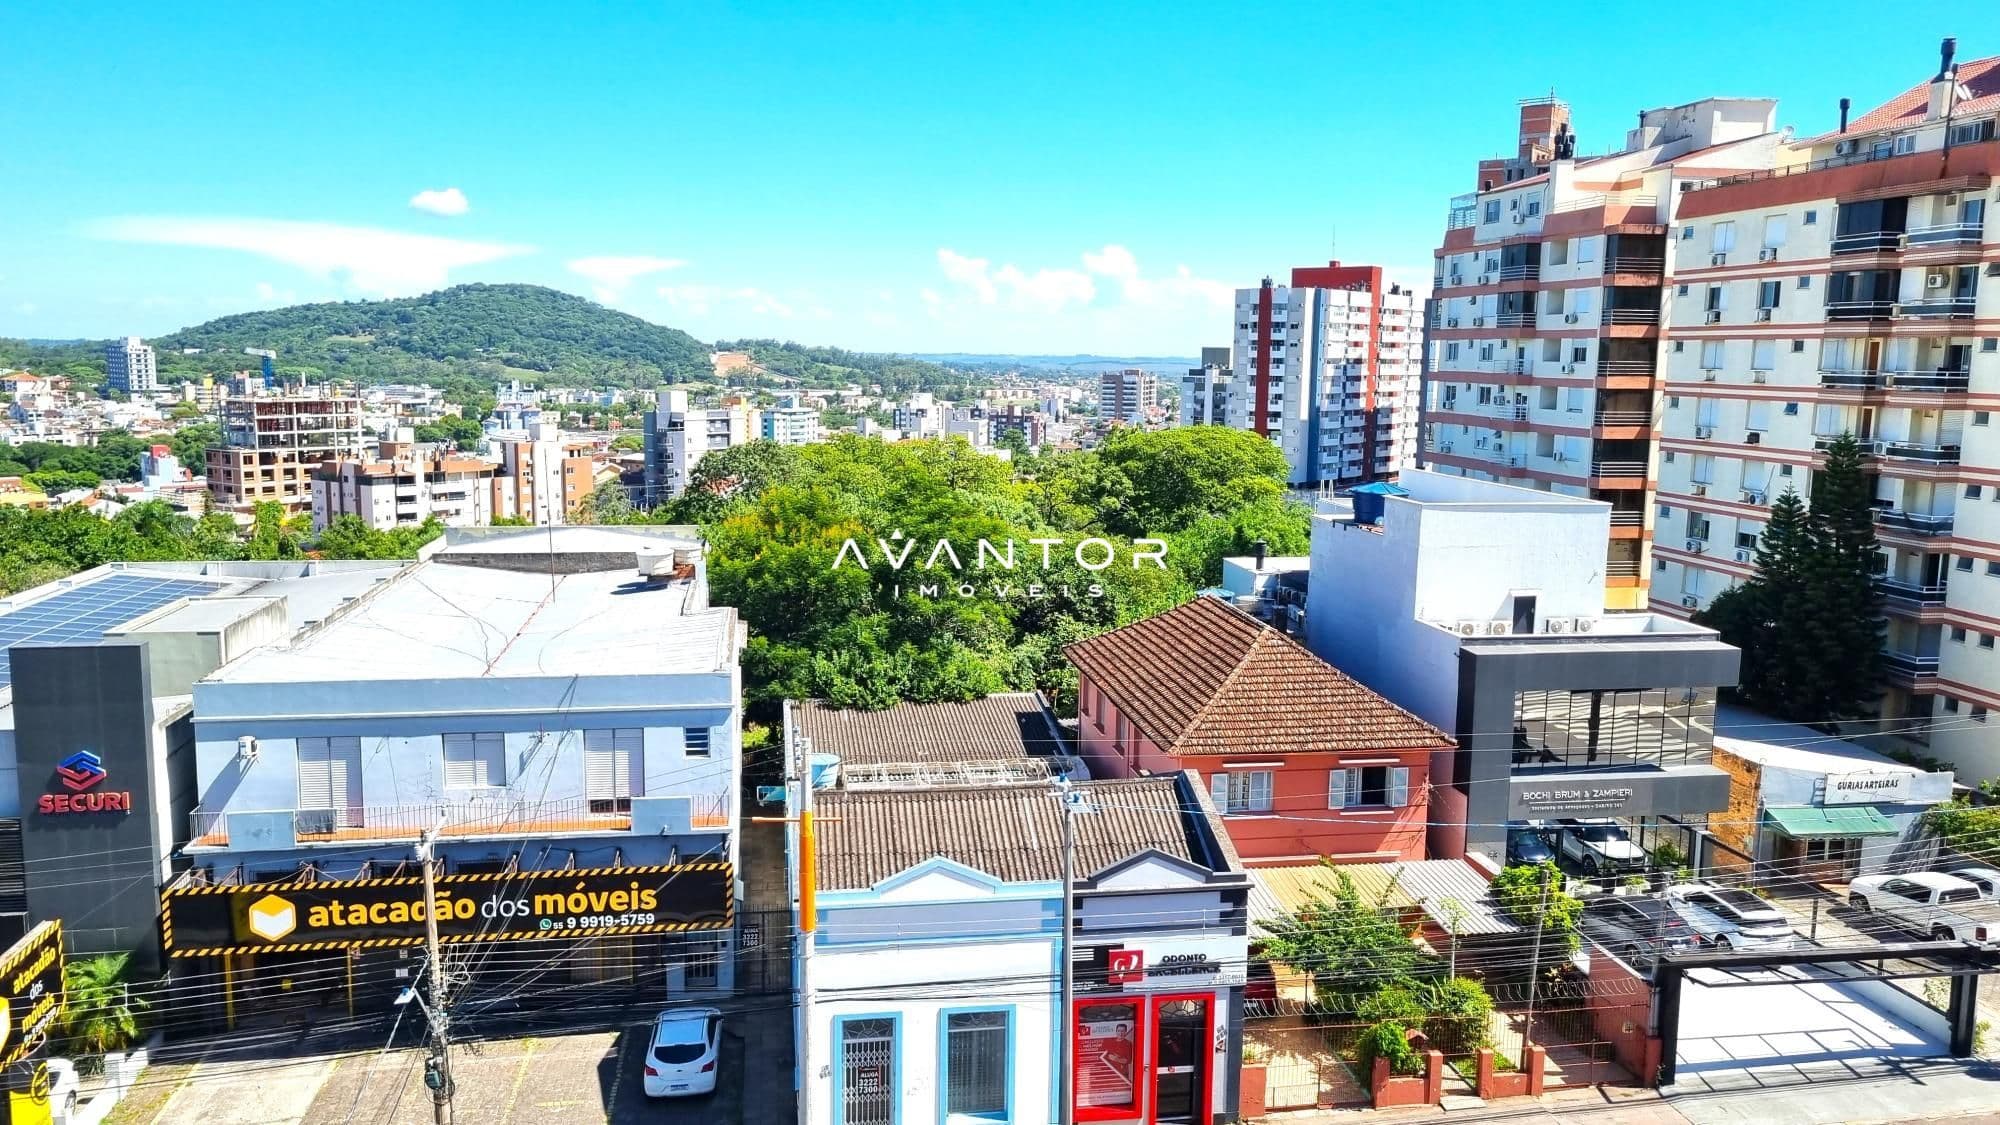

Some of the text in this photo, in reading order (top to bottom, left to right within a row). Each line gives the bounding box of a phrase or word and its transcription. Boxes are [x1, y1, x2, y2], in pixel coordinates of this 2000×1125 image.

[1837, 779, 1899, 791] GURIAS ARTEIRAS
[39, 792, 130, 813] SECURI
[1523, 791, 1551, 801] BOCHI
[1555, 790, 1580, 799] BRUM
[1592, 788, 1633, 798] ZAMPIERI
[308, 881, 657, 927] atacadão dos móveis
[553, 913, 655, 930] 55 9 9919-5759
[1162, 954, 1207, 963] ODONTO
[13, 945, 56, 994] atacadão
[29, 980, 44, 1000] dos
[22, 992, 55, 1033] móveis
[858, 1086, 878, 1094] 7300
